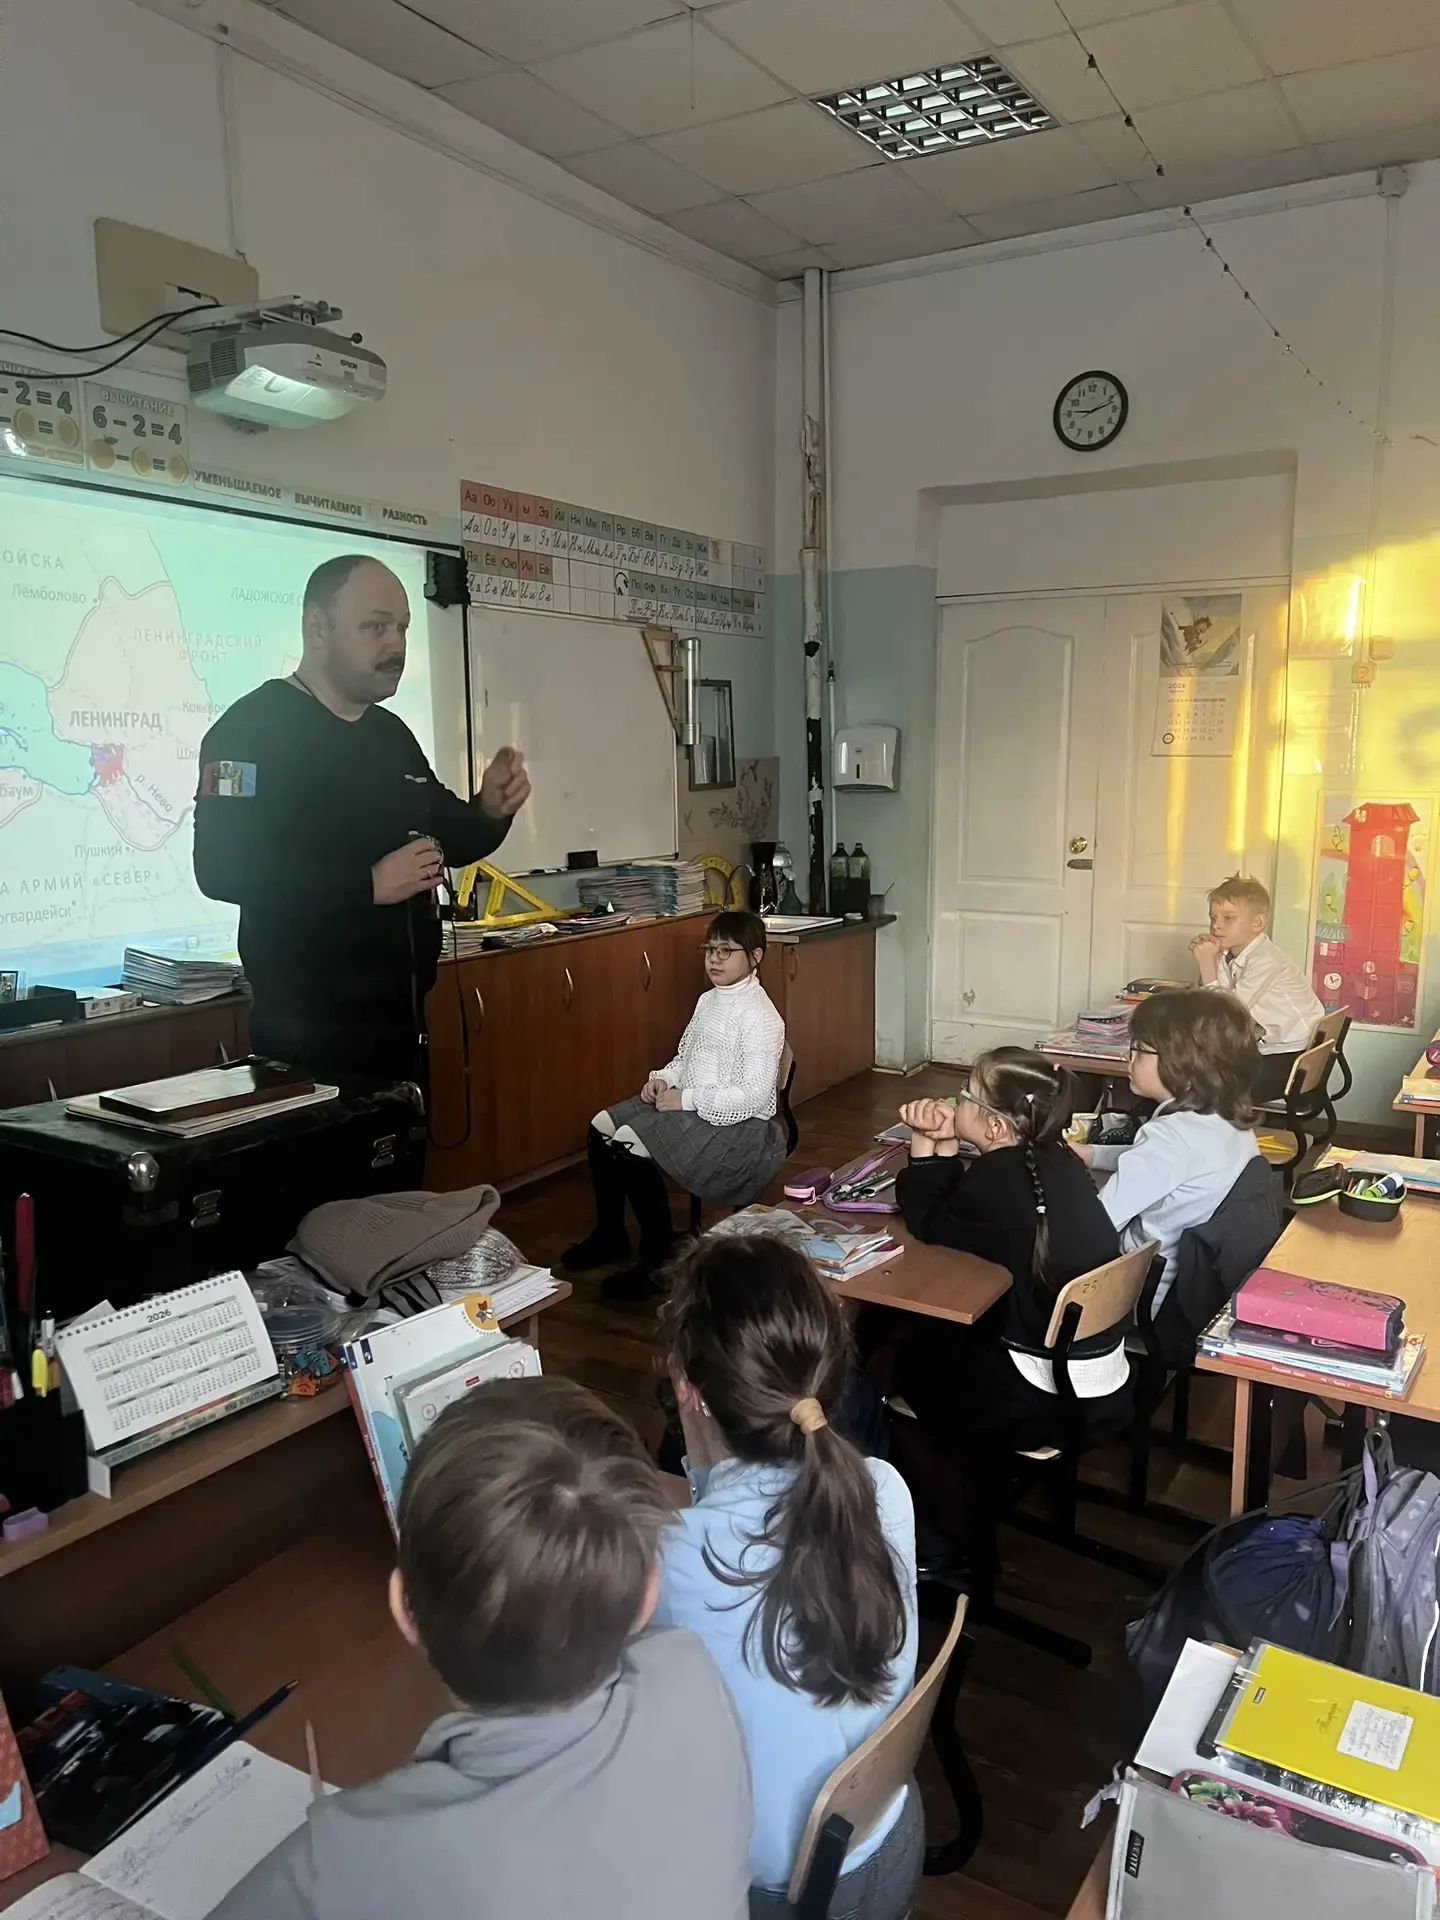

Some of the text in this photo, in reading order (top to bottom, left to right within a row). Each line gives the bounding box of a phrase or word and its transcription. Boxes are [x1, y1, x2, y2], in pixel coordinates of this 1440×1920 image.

[102, 389, 174, 417] ВЫЧИТАНИЕ
[194, 469, 281, 499] УМЕНЬШАЕМОЕ
[294, 492, 362, 516] ВЫЧИТАЕМОЕ
[465, 490, 477, 502] Аа
[483, 494, 496, 507] Оо
[503, 498, 513, 513] Уу
[382, 507, 427, 526] РАЗНОСТЬ
[2, 548, 65, 570] ОЙСКА
[501, 557, 517, 569] Юю
[539, 563, 550, 575] Ее
[13, 583, 86, 603] Лемболово
[231, 587, 295, 605] ЛАДОЖСКОЕ
[133, 628, 263, 648] ЛЕНИНГРАДСКИЙ
[179, 650, 228, 665] ФРОНТ
[69, 710, 162, 732] ЛЕНИНГРАД
[0, 783, 33, 799] баум
[74, 844, 122, 858] Пушкин
[20, 873, 83, 894] АРМИЙ
[146, 1309, 172, 1324] 2026
